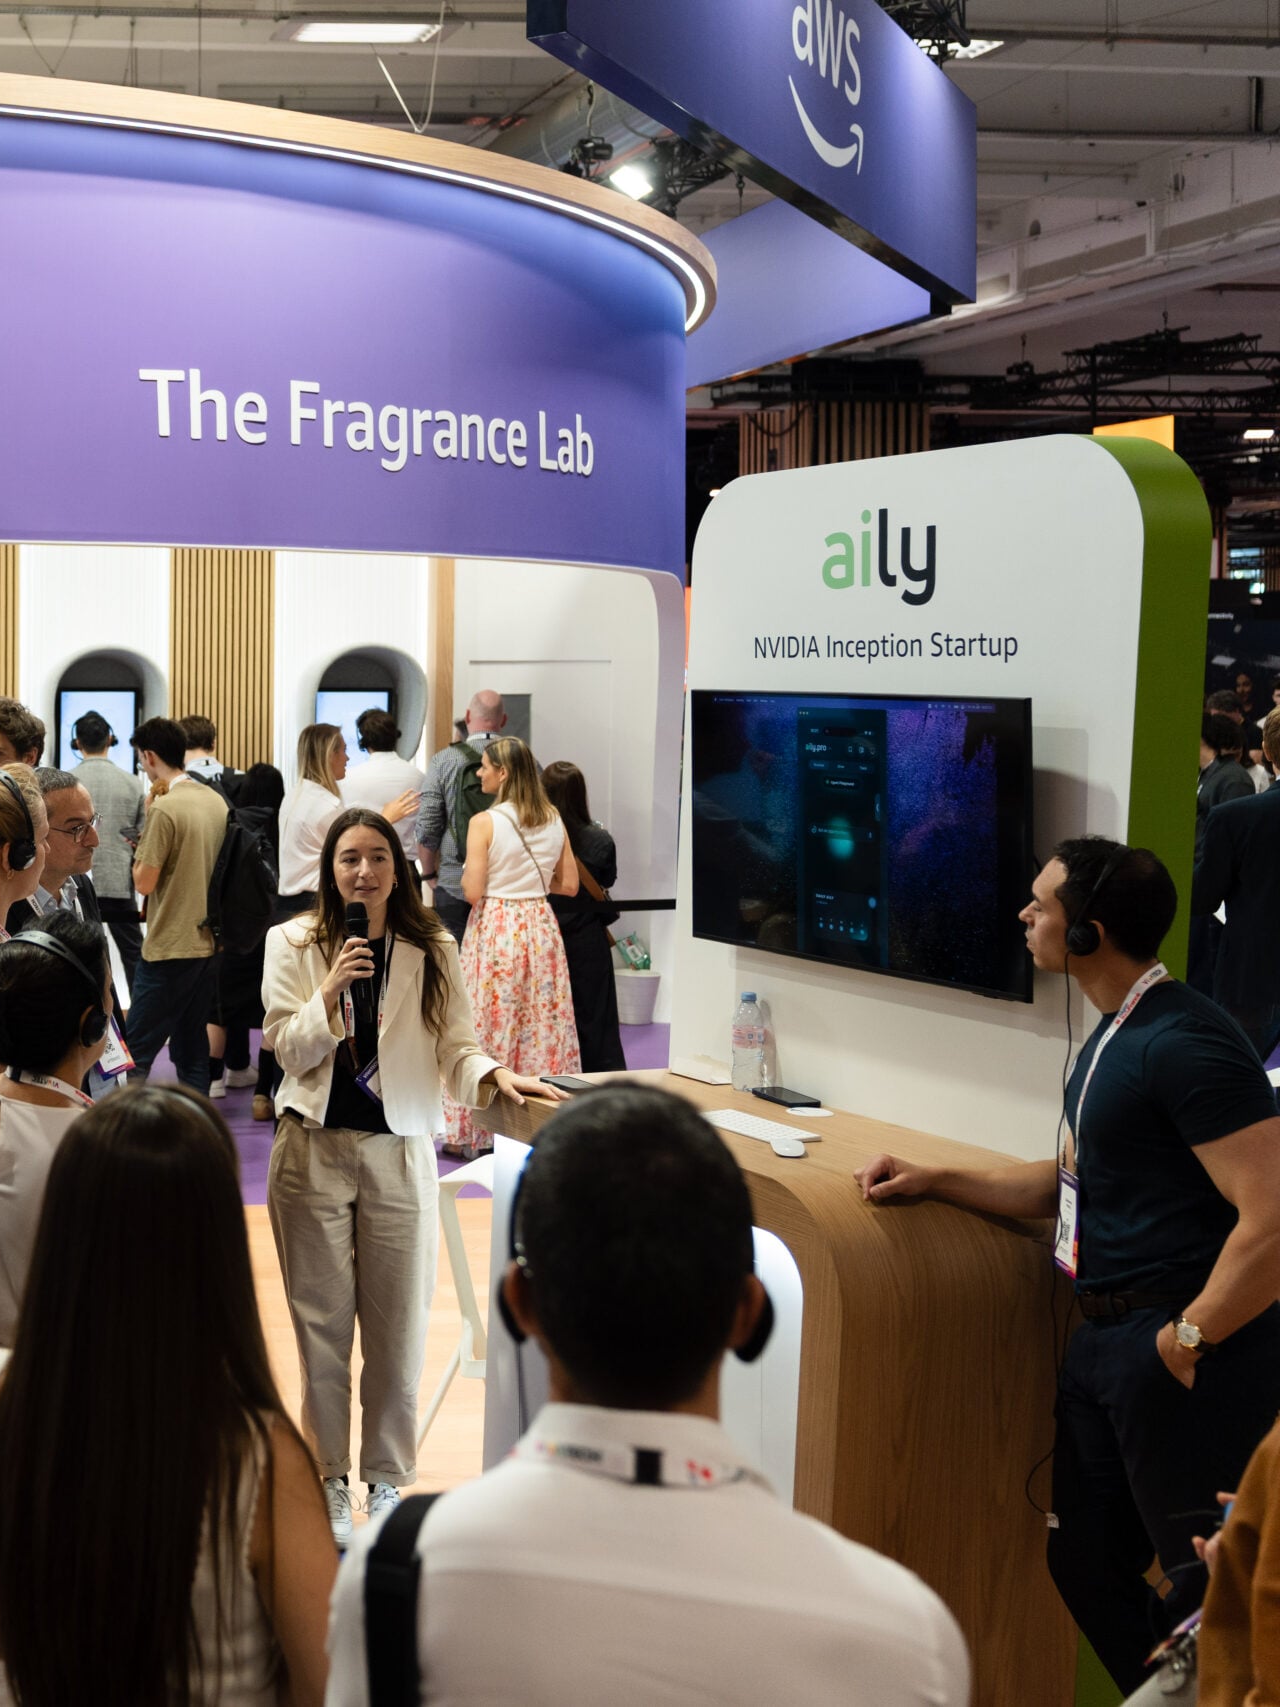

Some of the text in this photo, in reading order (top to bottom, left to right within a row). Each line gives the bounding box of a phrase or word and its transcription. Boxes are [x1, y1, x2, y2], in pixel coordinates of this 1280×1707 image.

[792, 0, 861, 106] aws
[138, 368, 595, 476] The Fragrance Lab
[821, 508, 937, 607] aily
[754, 631, 1018, 665] NVIDIA Inception Startup
